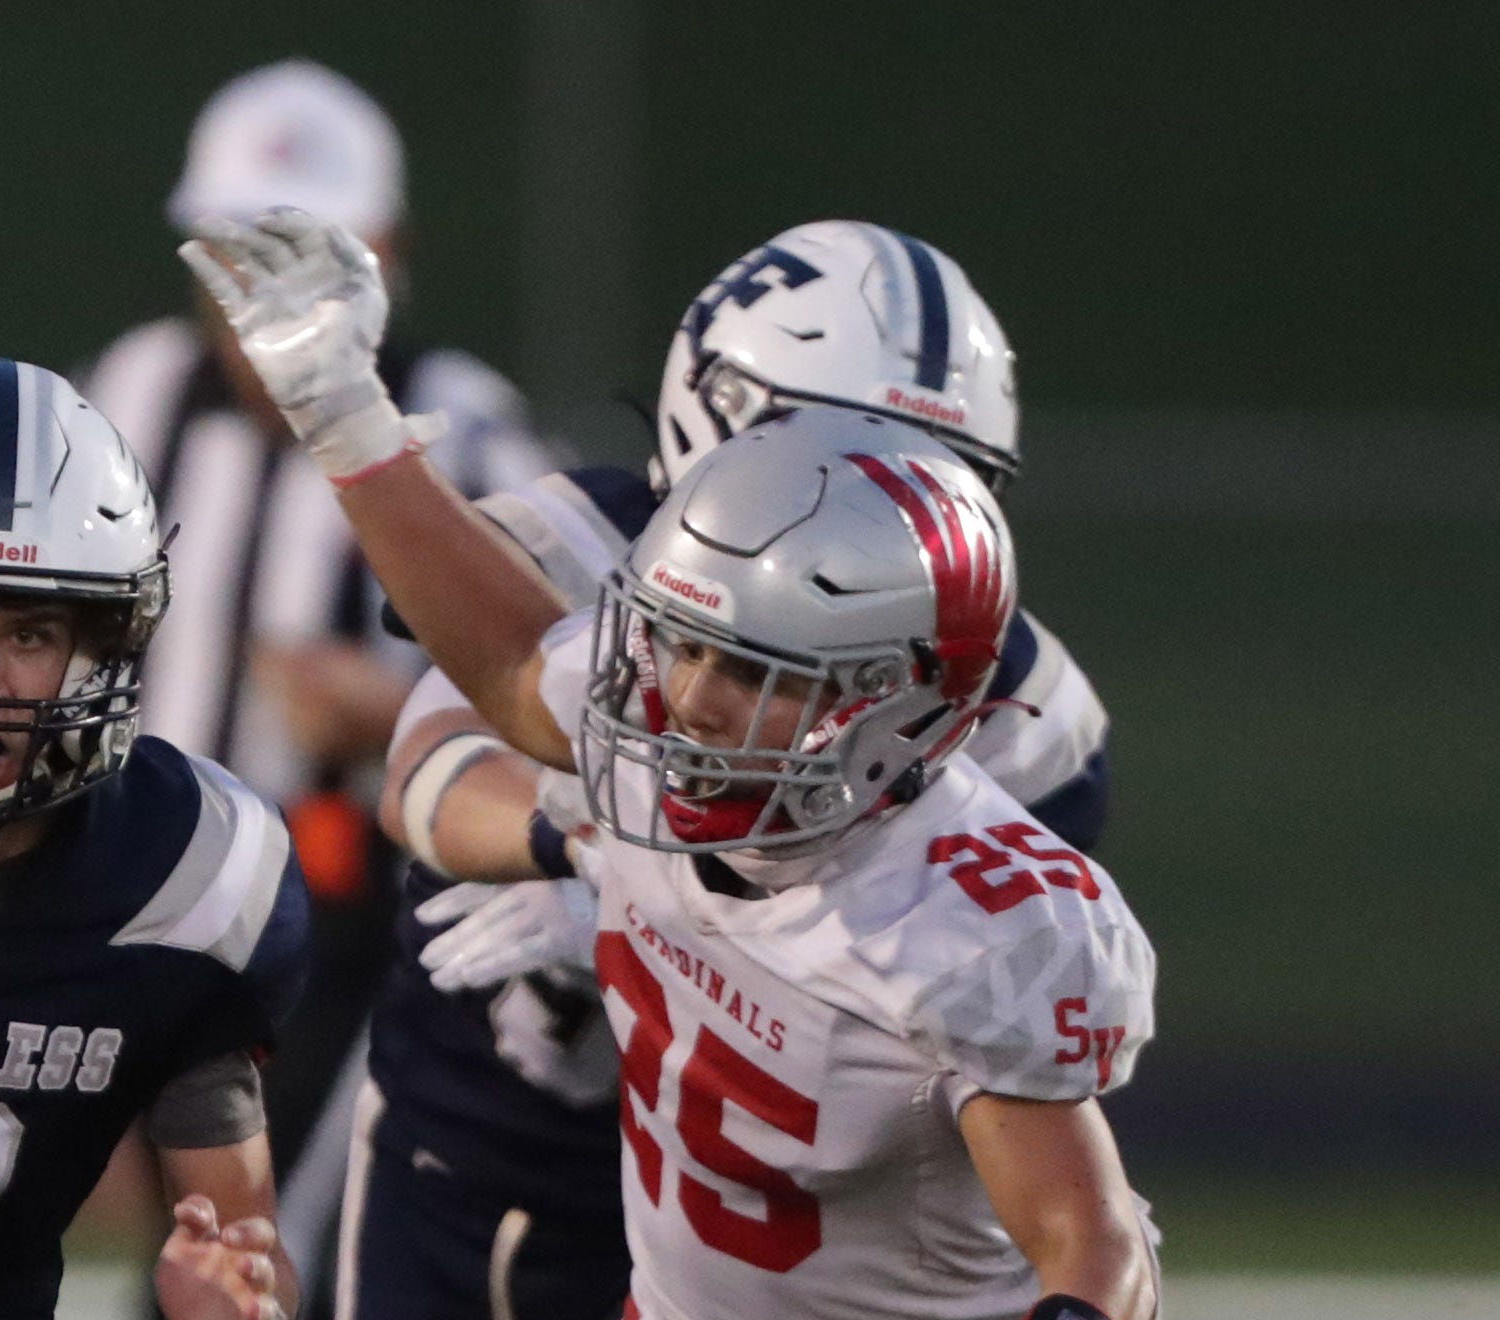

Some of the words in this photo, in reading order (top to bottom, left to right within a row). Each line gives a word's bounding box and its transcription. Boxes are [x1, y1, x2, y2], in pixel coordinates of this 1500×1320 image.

[886, 387, 965, 425] Riddell
[654, 565, 721, 609] Riddell
[926, 821, 1101, 915] 25
[594, 930, 823, 1274] 25
